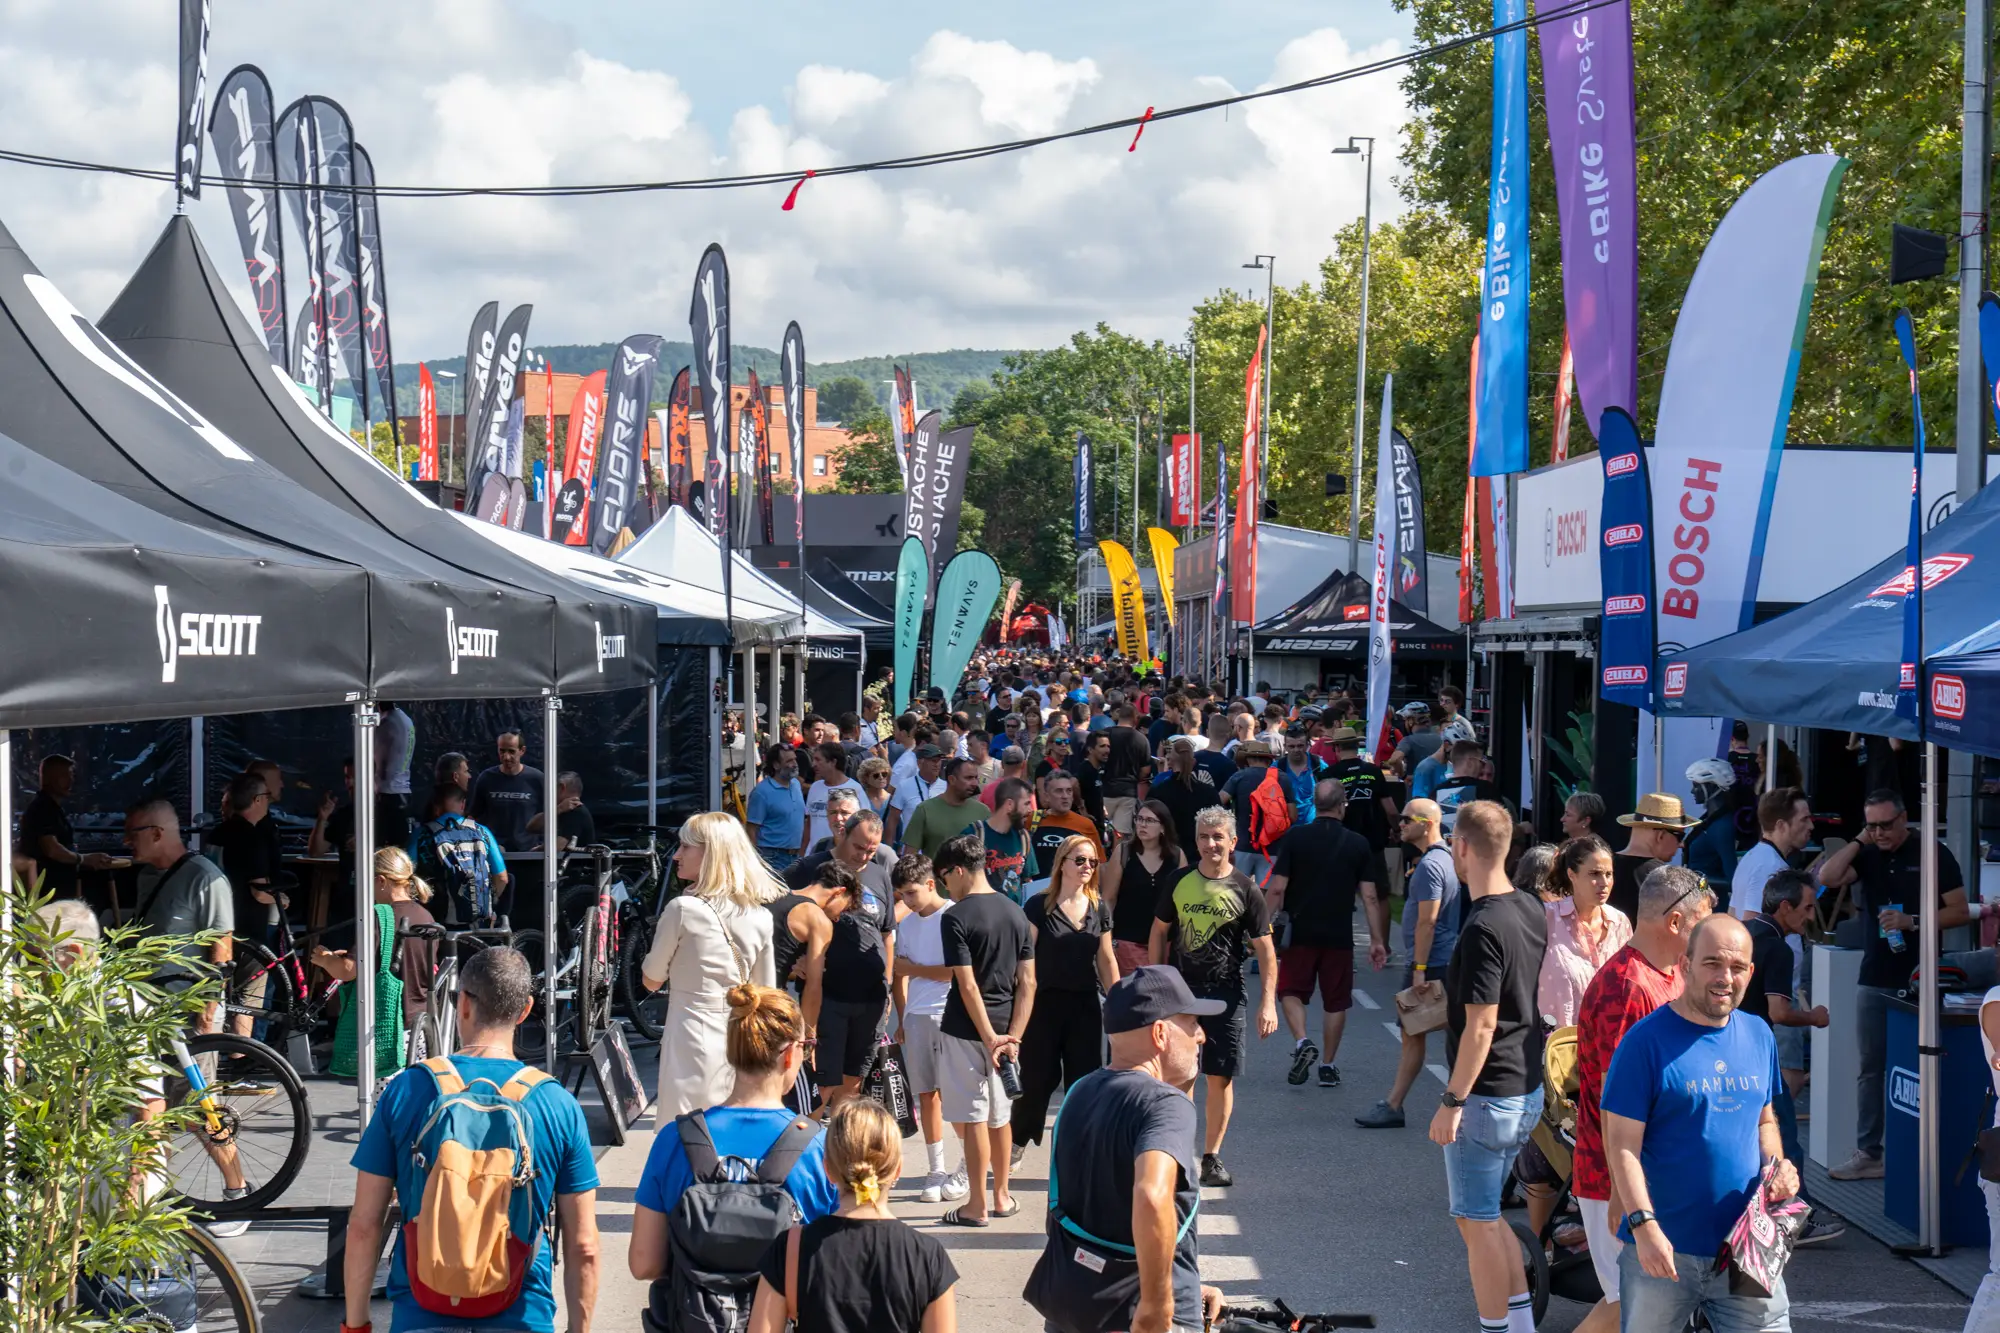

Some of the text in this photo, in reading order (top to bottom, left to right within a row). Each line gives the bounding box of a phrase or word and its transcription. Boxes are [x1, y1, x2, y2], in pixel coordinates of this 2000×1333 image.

[580, 391, 598, 457] CRUZ
[670, 404, 689, 466] FOX
[1558, 509, 1587, 556] BOSCH
[1662, 458, 1722, 619] BOSCH
[845, 571, 897, 582] max
[1375, 532, 1386, 623] BOSCH
[902, 571, 918, 648] TENWAYS
[947, 579, 978, 648] TENWAYS
[179, 614, 261, 656] SCOTT
[458, 626, 498, 658] SCOTT
[601, 634, 625, 658] SCOTT
[1666, 669, 1684, 689] ABUS
[1936, 684, 1961, 709] ABUS
[489, 791, 532, 800] TREK
[1686, 1075, 1759, 1095] MAMMUT
